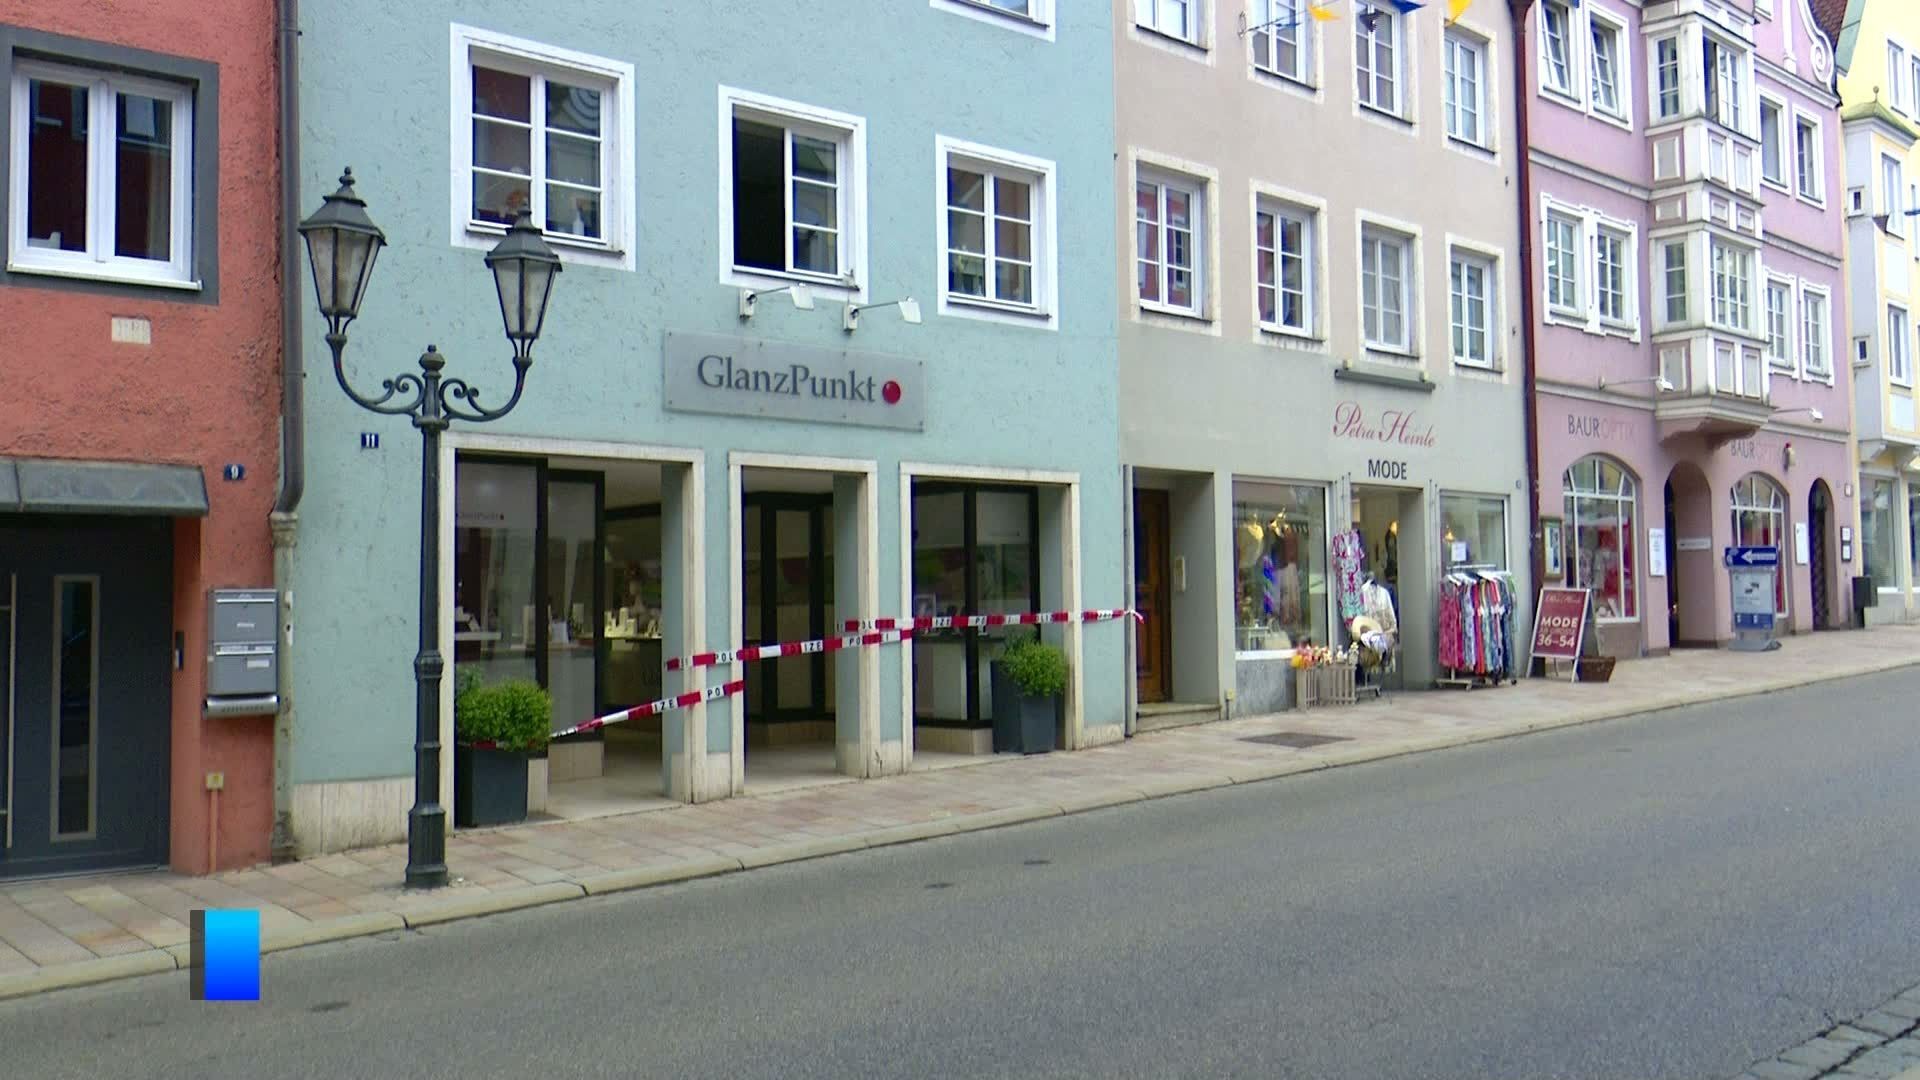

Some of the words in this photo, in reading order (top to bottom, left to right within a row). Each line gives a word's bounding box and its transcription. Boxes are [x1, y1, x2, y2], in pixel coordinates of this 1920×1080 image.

[697, 354, 876, 403] GlanzPunkt
[1333, 400, 1375, 440] Petra
[1378, 410, 1436, 448] Heinle
[364, 433, 375, 448] 11
[230, 465, 239, 480] 9
[1368, 459, 1408, 480] MODE
[1540, 616, 1579, 629] MODE
